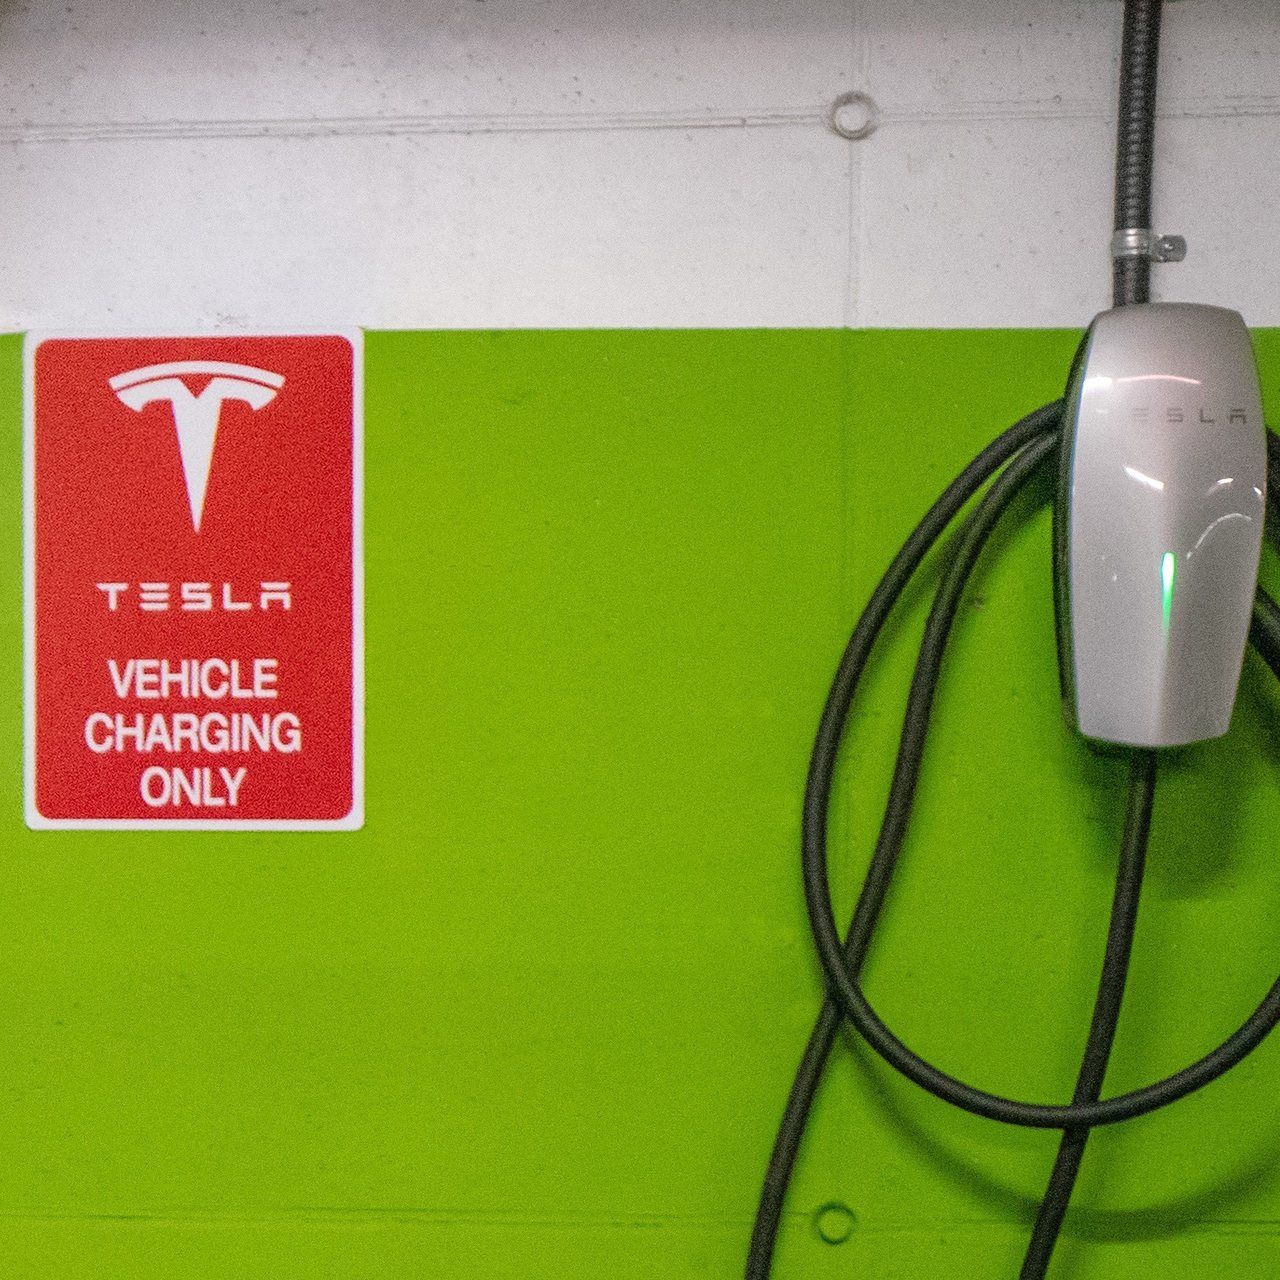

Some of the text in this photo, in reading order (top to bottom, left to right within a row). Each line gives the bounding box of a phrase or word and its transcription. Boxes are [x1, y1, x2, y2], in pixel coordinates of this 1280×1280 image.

[1096, 407, 1247, 425] ESLA
[96, 581, 292, 611] TESLA
[107, 658, 278, 699] VEHICLE
[84, 712, 302, 754] CHARGING
[140, 766, 247, 807] ONLY
